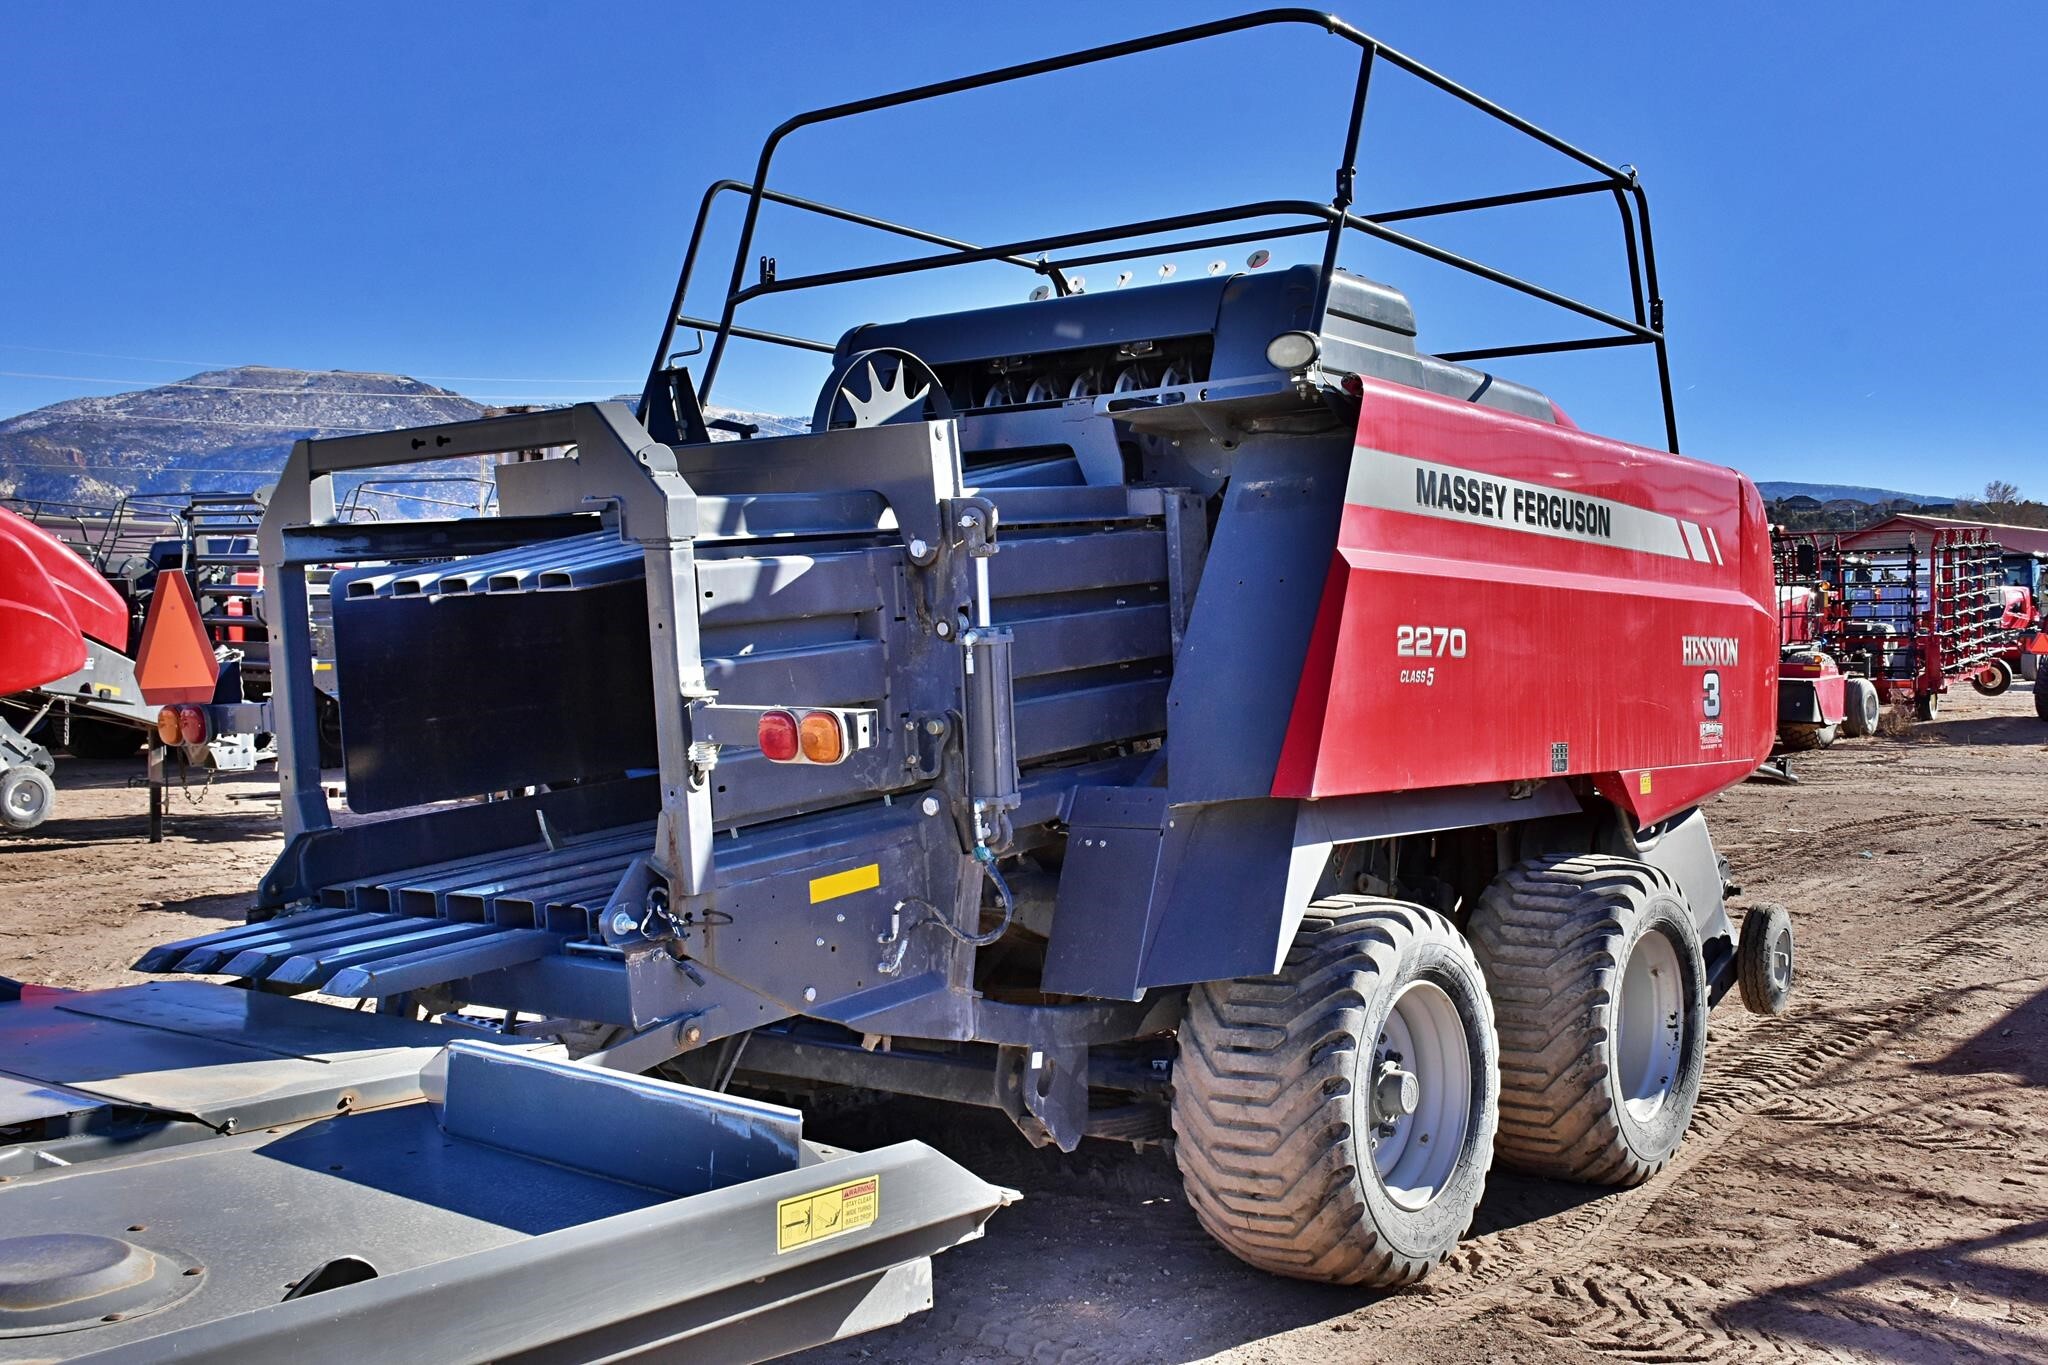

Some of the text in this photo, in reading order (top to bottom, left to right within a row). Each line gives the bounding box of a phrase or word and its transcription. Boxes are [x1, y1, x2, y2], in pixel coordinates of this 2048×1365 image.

[1416, 468, 1611, 538] MASSEY FERGUSON
[1397, 624, 1467, 658] 2270
[1682, 635, 1739, 667] HESSTON
[1703, 670, 1720, 719] 3
[849, 1183, 874, 1195] WARNING
